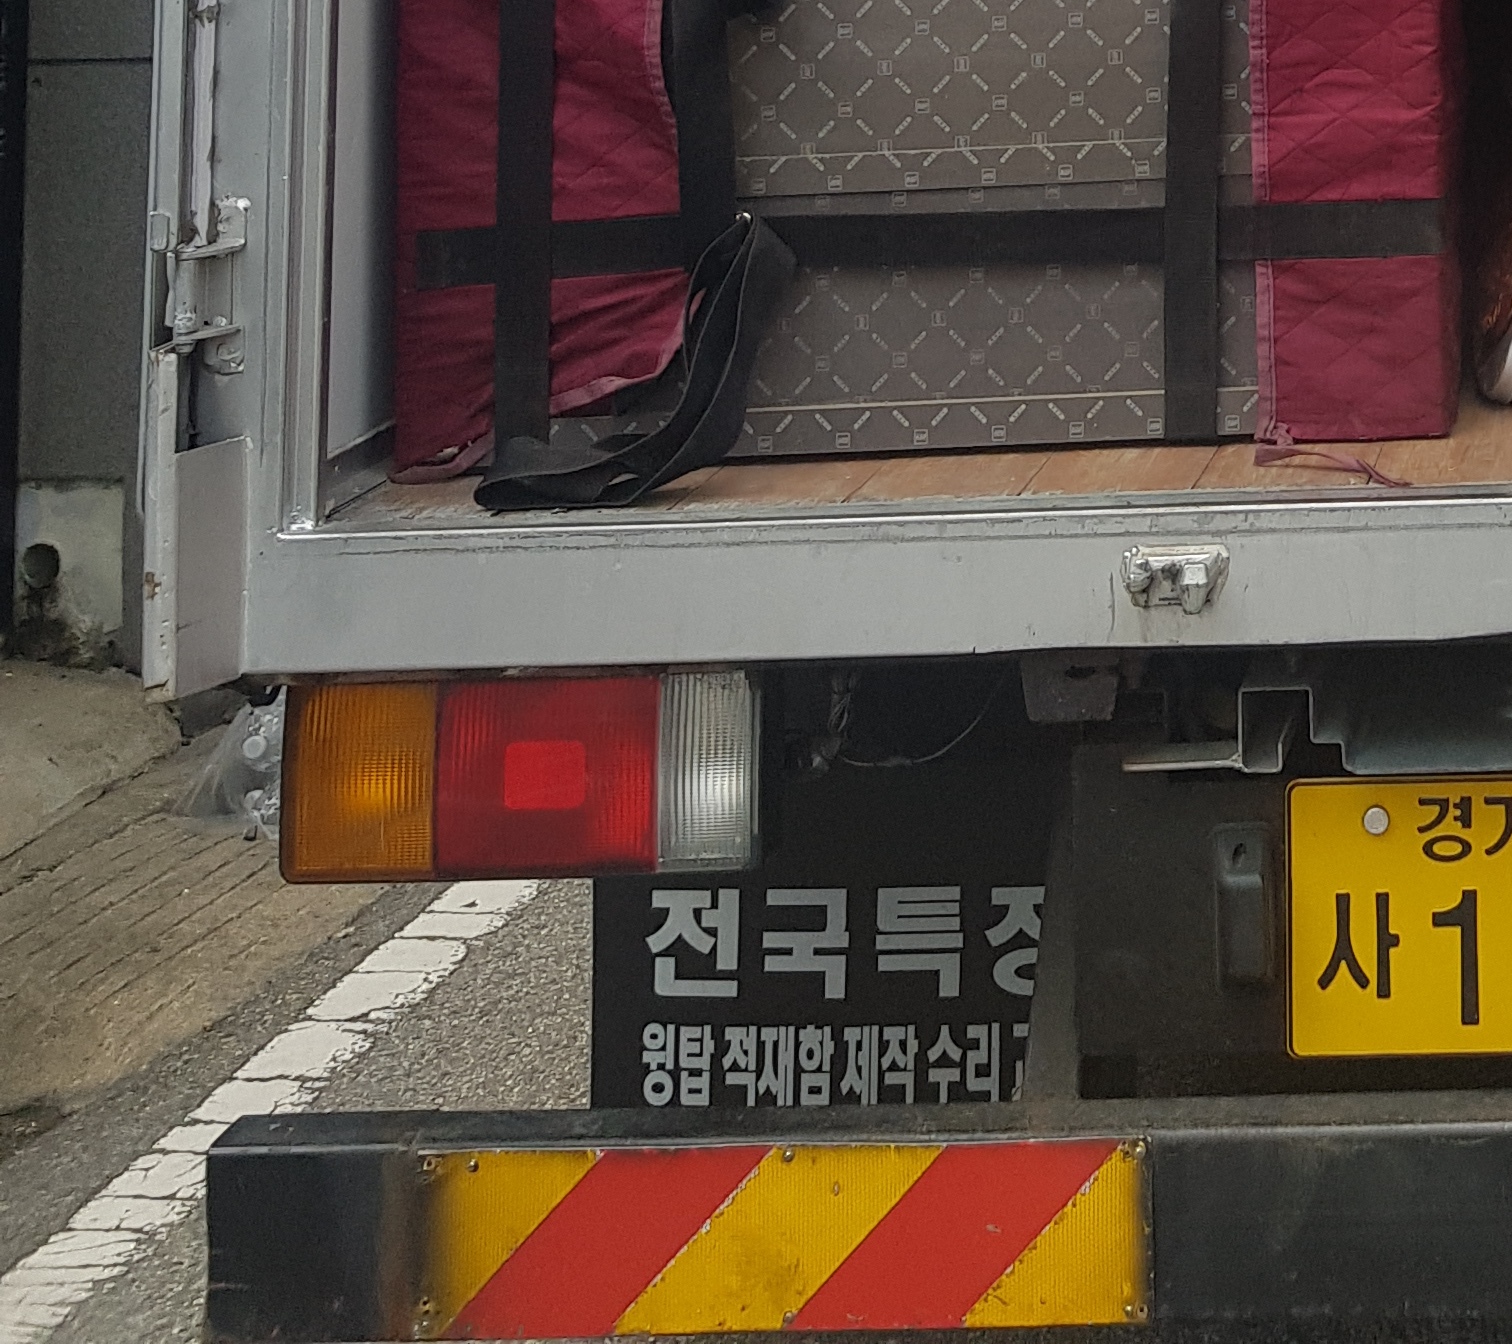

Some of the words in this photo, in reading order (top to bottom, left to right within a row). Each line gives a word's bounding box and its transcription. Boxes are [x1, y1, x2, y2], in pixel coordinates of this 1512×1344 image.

[642, 1023, 715, 1107] 윙탑
[721, 1024, 835, 1108] 적재함
[839, 1023, 919, 1106] 제작
[926, 1022, 1001, 1104] 수리
